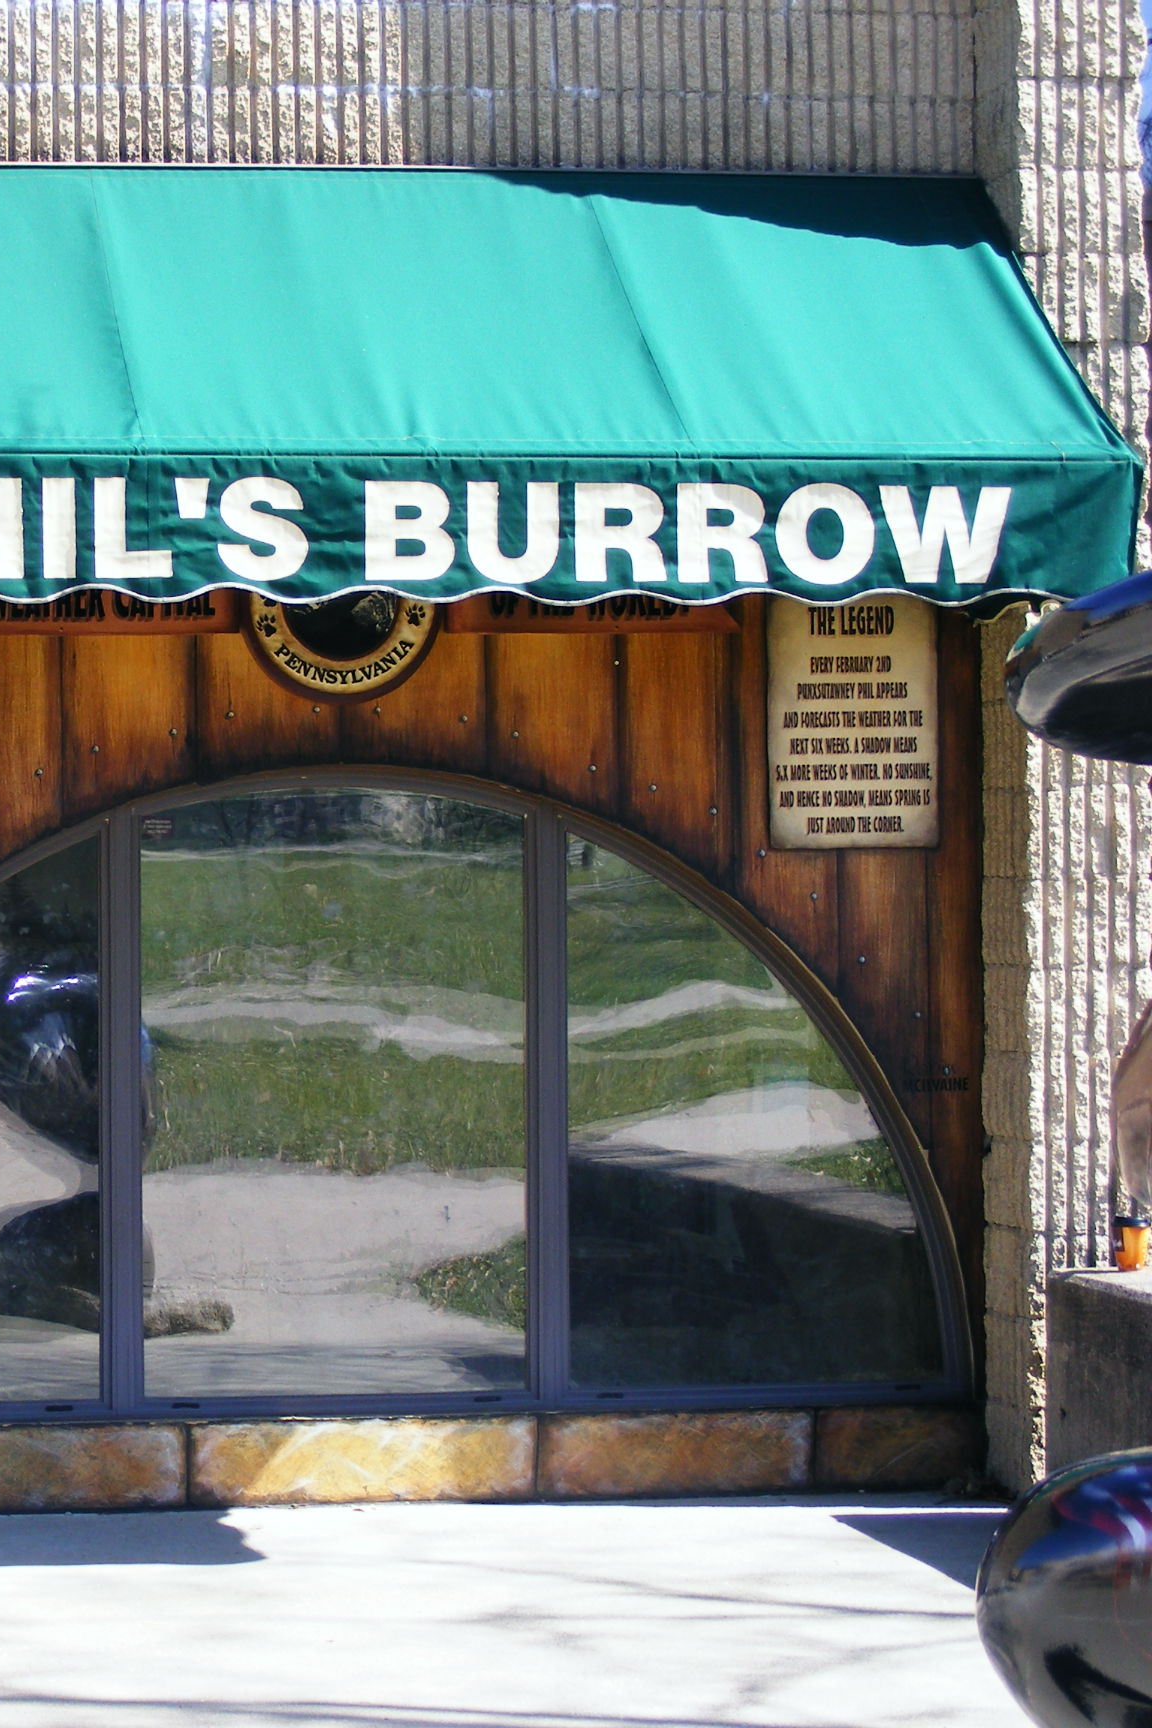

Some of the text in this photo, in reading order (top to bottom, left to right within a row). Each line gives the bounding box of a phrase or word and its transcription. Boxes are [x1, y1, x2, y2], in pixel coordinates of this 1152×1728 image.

[363, 479, 1011, 585] BURROW
[808, 605, 894, 635] THE LEGEND
[274, 640, 414, 684] PENNSYLVANIA
[811, 656, 891, 673] EVERY FEBRUARY 2ND
[798, 682, 907, 700] PUNXSUTAWNEY PHIL APPEARS
[783, 710, 922, 728] AND FORECASTS THE WEATHER FOR THE
[790, 739, 808, 754] NEXT
[811, 738, 823, 754] SIX
[854, 738, 858, 753] A
[862, 737, 891, 753] SHADOW
[893, 737, 917, 753] MEANS
[791, 765, 810, 780] MORE
[813, 764, 836, 780] WEEKS
[839, 764, 848, 780] OF
[883, 764, 892, 779] NO
[780, 791, 794, 807] AND
[797, 791, 819, 807] HENCE
[822, 790, 832, 806] NO
[868, 790, 892, 806] MEANS
[895, 789, 921, 806] SPRING
[923, 789, 929, 805] IS
[807, 817, 824, 834] JUST
[826, 817, 855, 833] AROUND
[858, 816, 871, 832] THE
